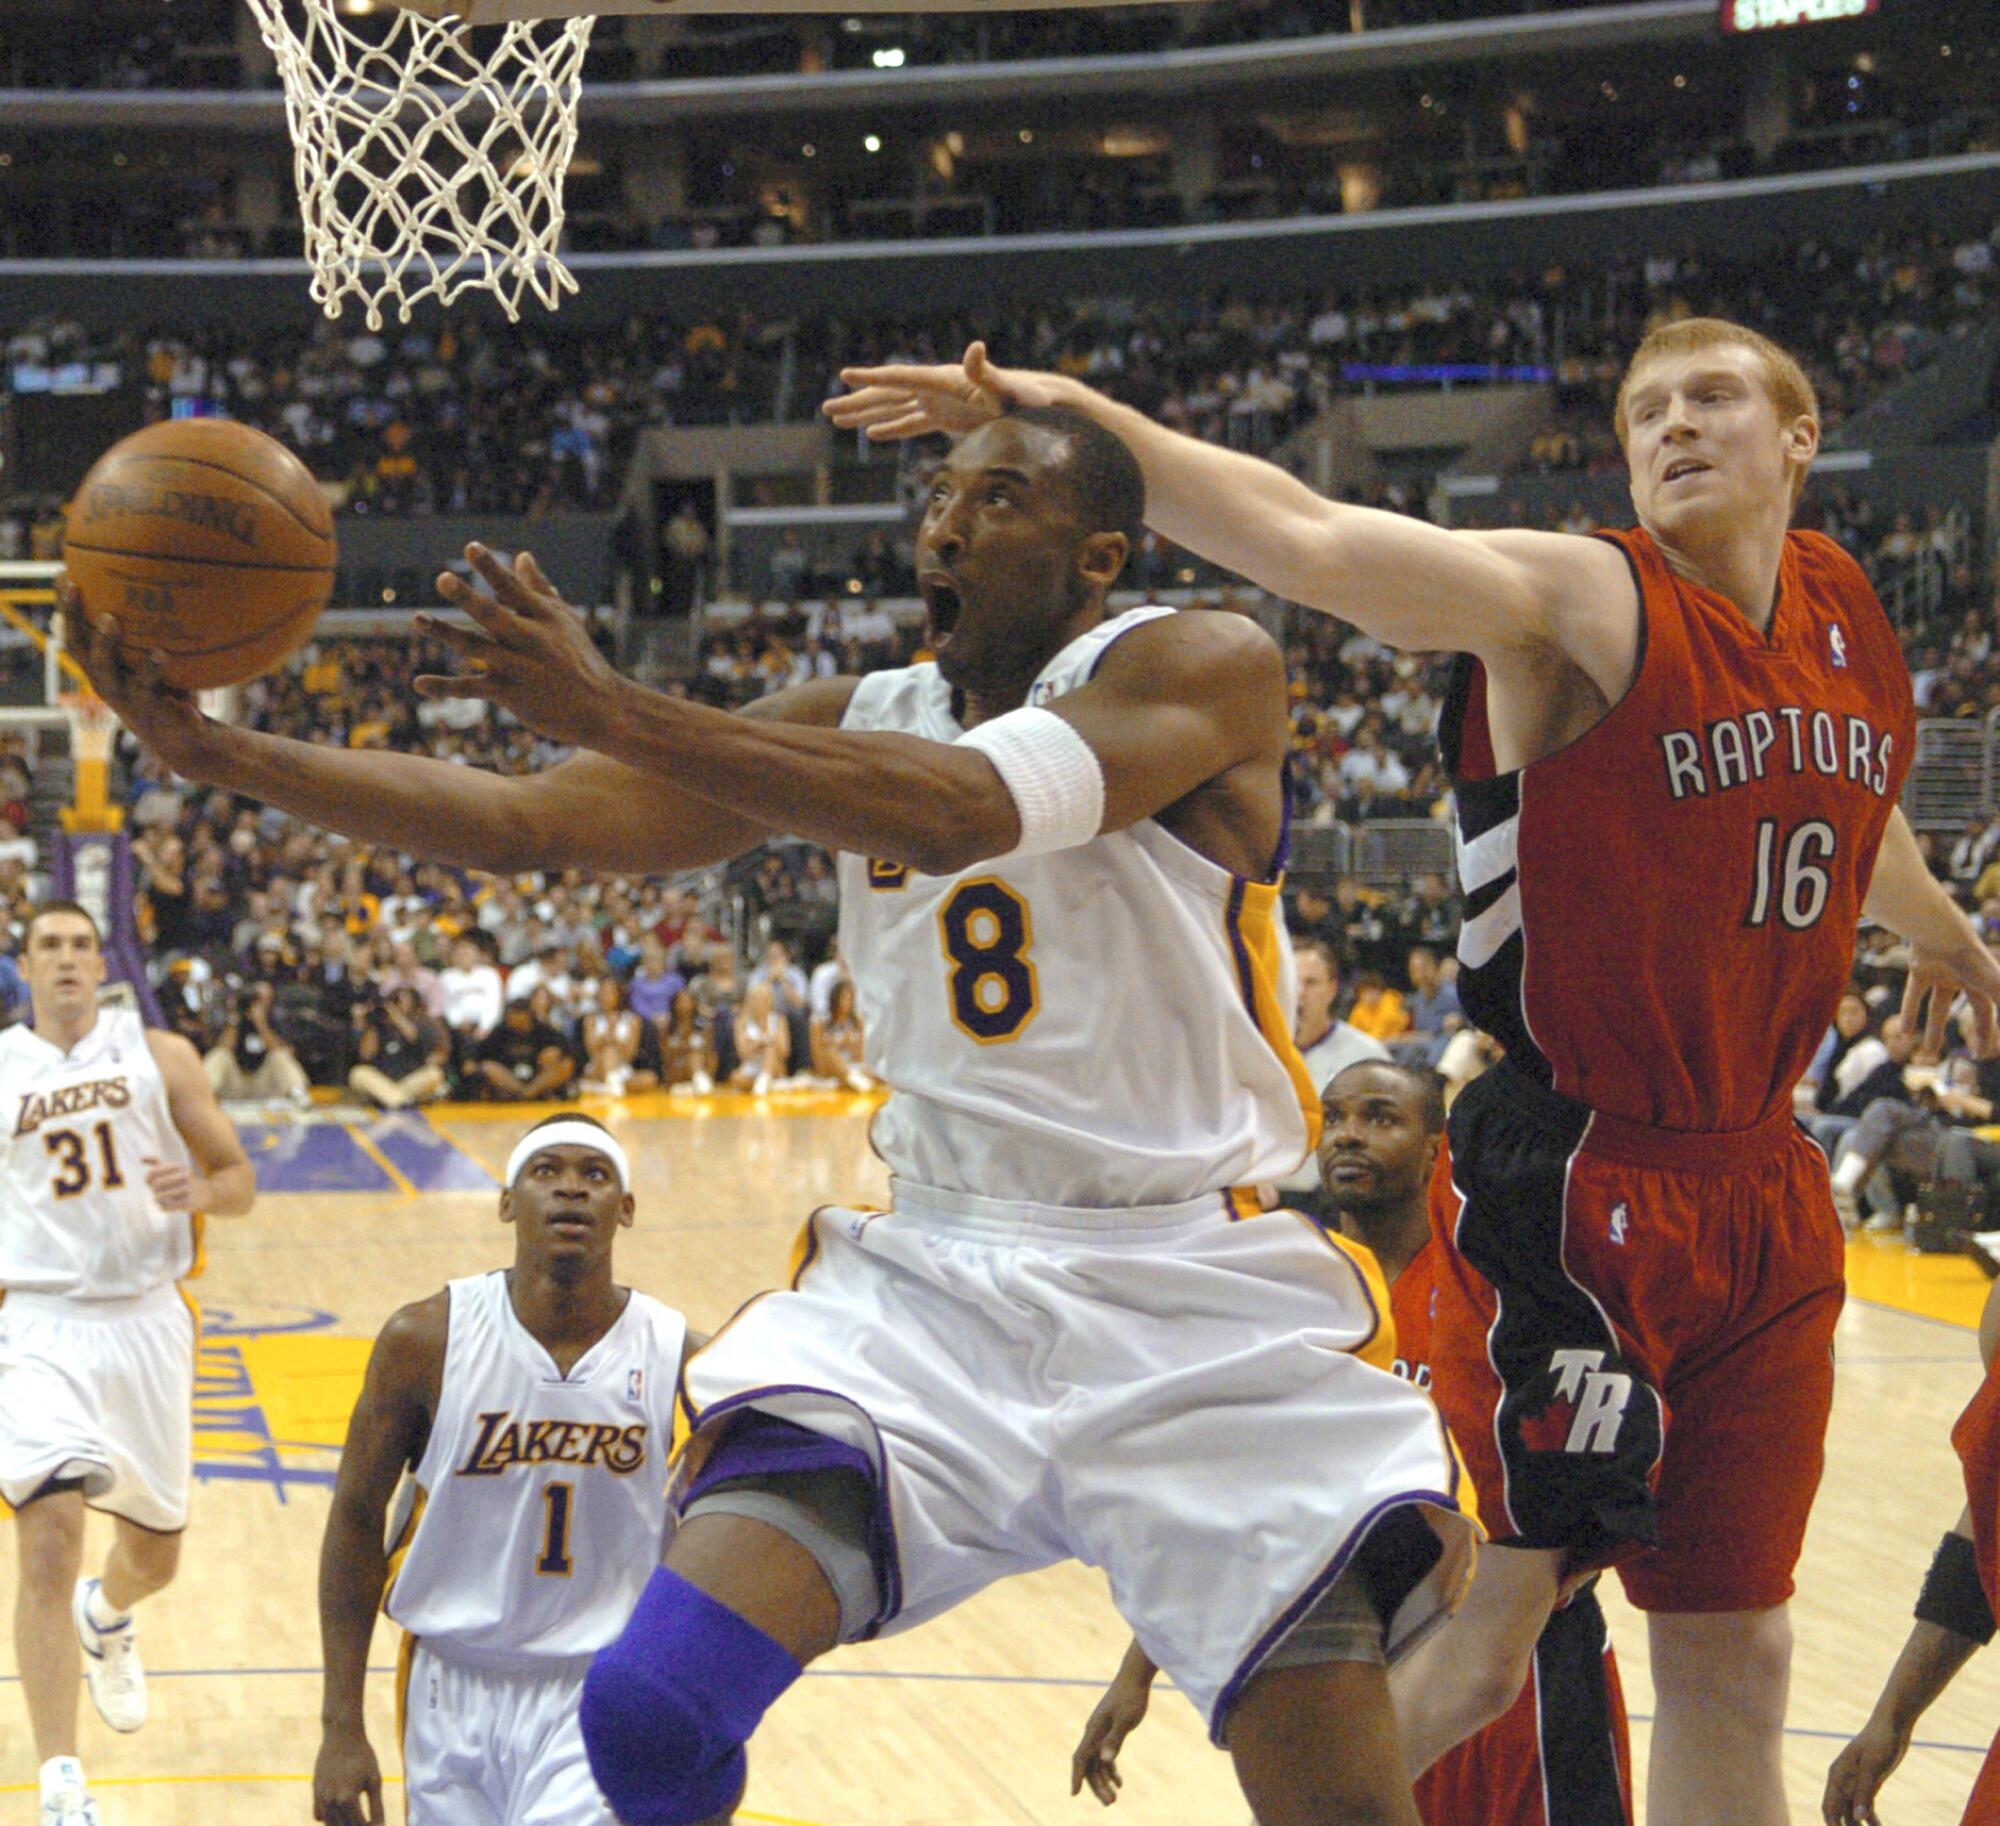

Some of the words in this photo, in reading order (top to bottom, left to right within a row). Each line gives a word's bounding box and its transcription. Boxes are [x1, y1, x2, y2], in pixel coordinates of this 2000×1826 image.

[1661, 707, 1893, 799] RAPTORS
[1743, 815, 1837, 932] 16
[936, 874, 1041, 1046] 8
[11, 1076, 132, 1139] LAKERS
[44, 1119, 126, 1201] 31
[454, 1410, 649, 1478] LAKERS
[534, 1479, 574, 1577] 1
